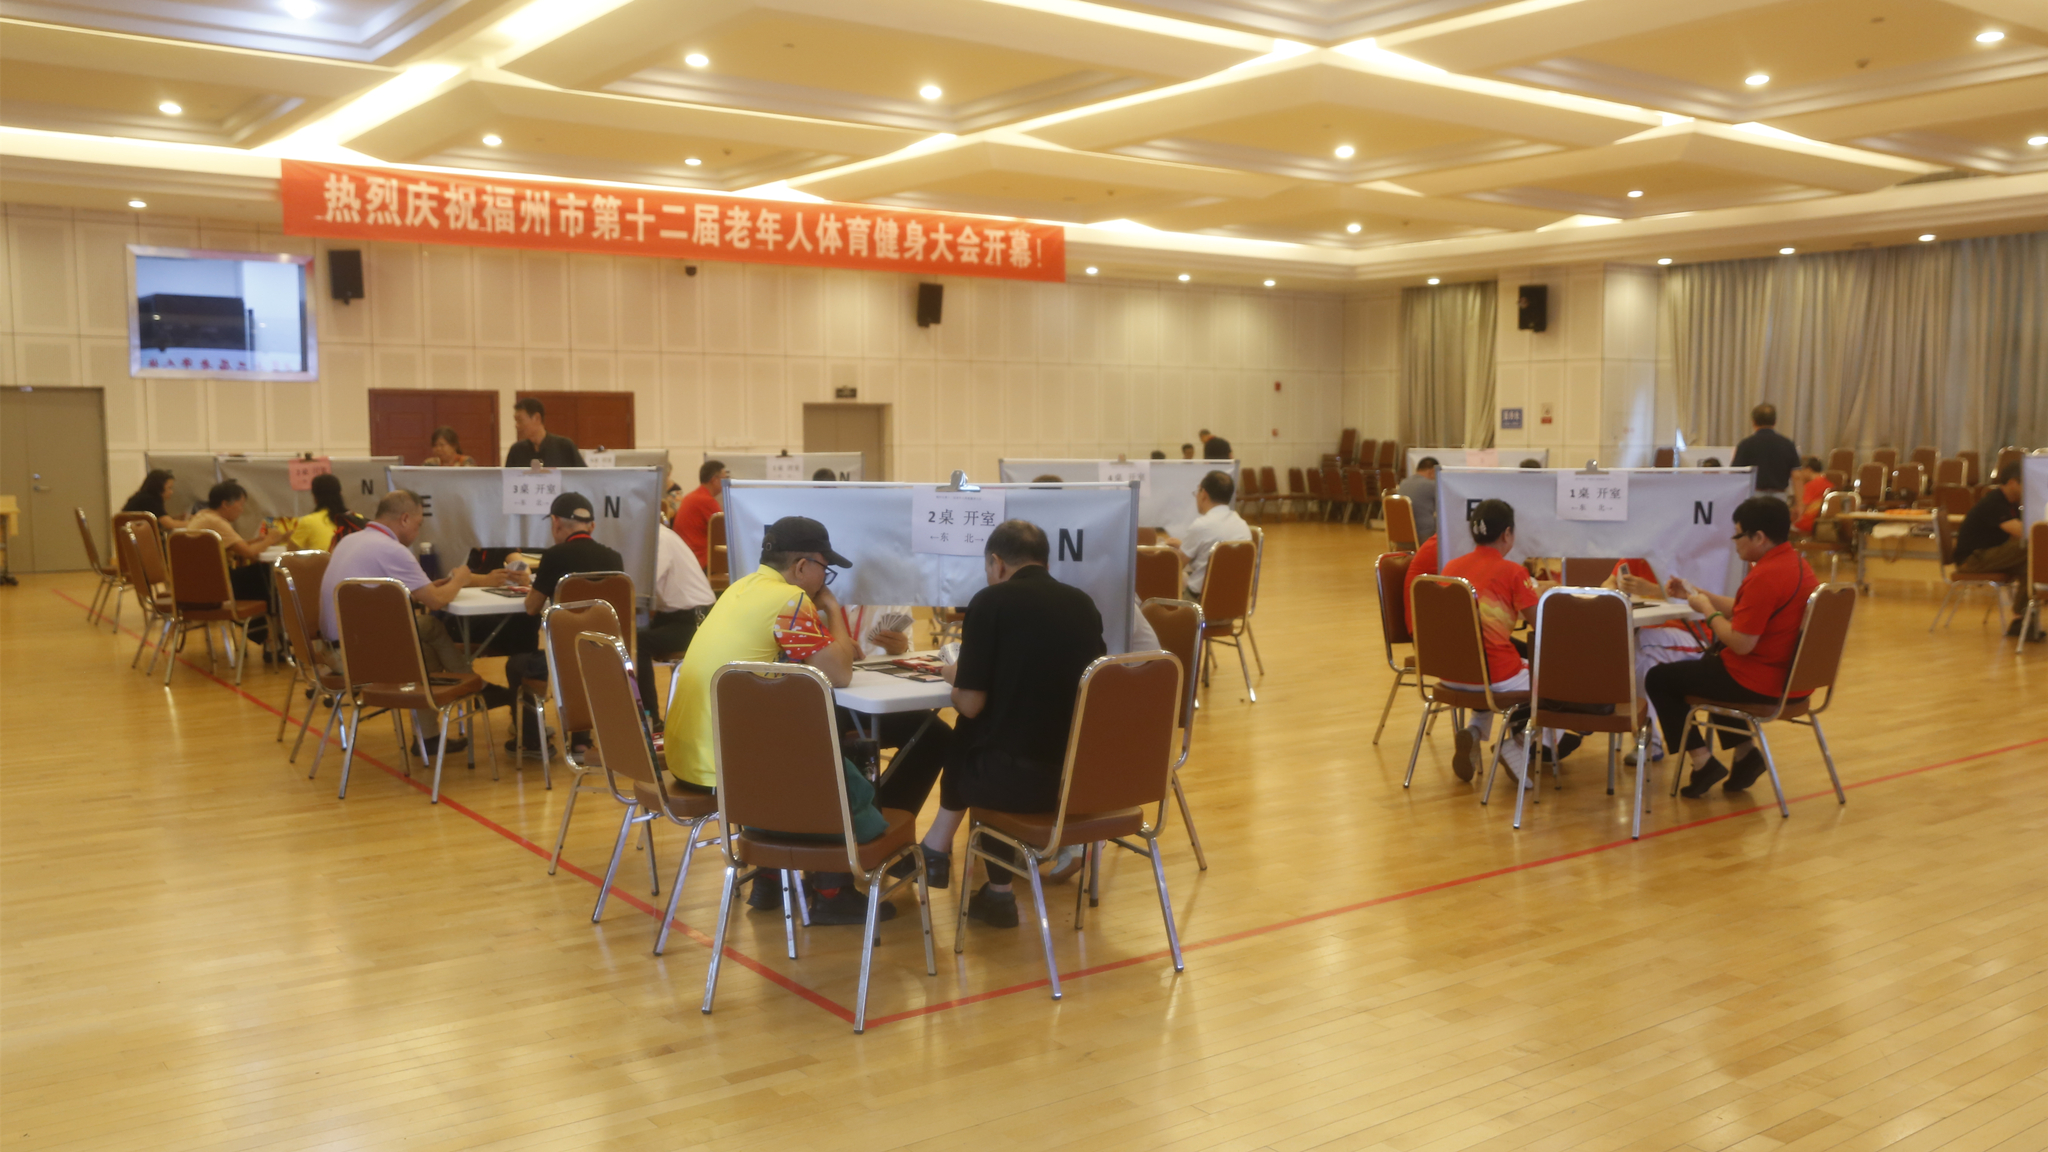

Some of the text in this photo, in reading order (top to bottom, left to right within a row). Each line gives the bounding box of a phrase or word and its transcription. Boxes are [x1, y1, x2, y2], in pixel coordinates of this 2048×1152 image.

[361, 479, 374, 495] N
[1569, 487, 1621, 499] 1桌 开室
[604, 495, 620, 518] N
[1693, 500, 1713, 525] N
[928, 509, 996, 527] 2桌 开室
[940, 532, 974, 543] 东 北
[1058, 528, 1083, 562] N
